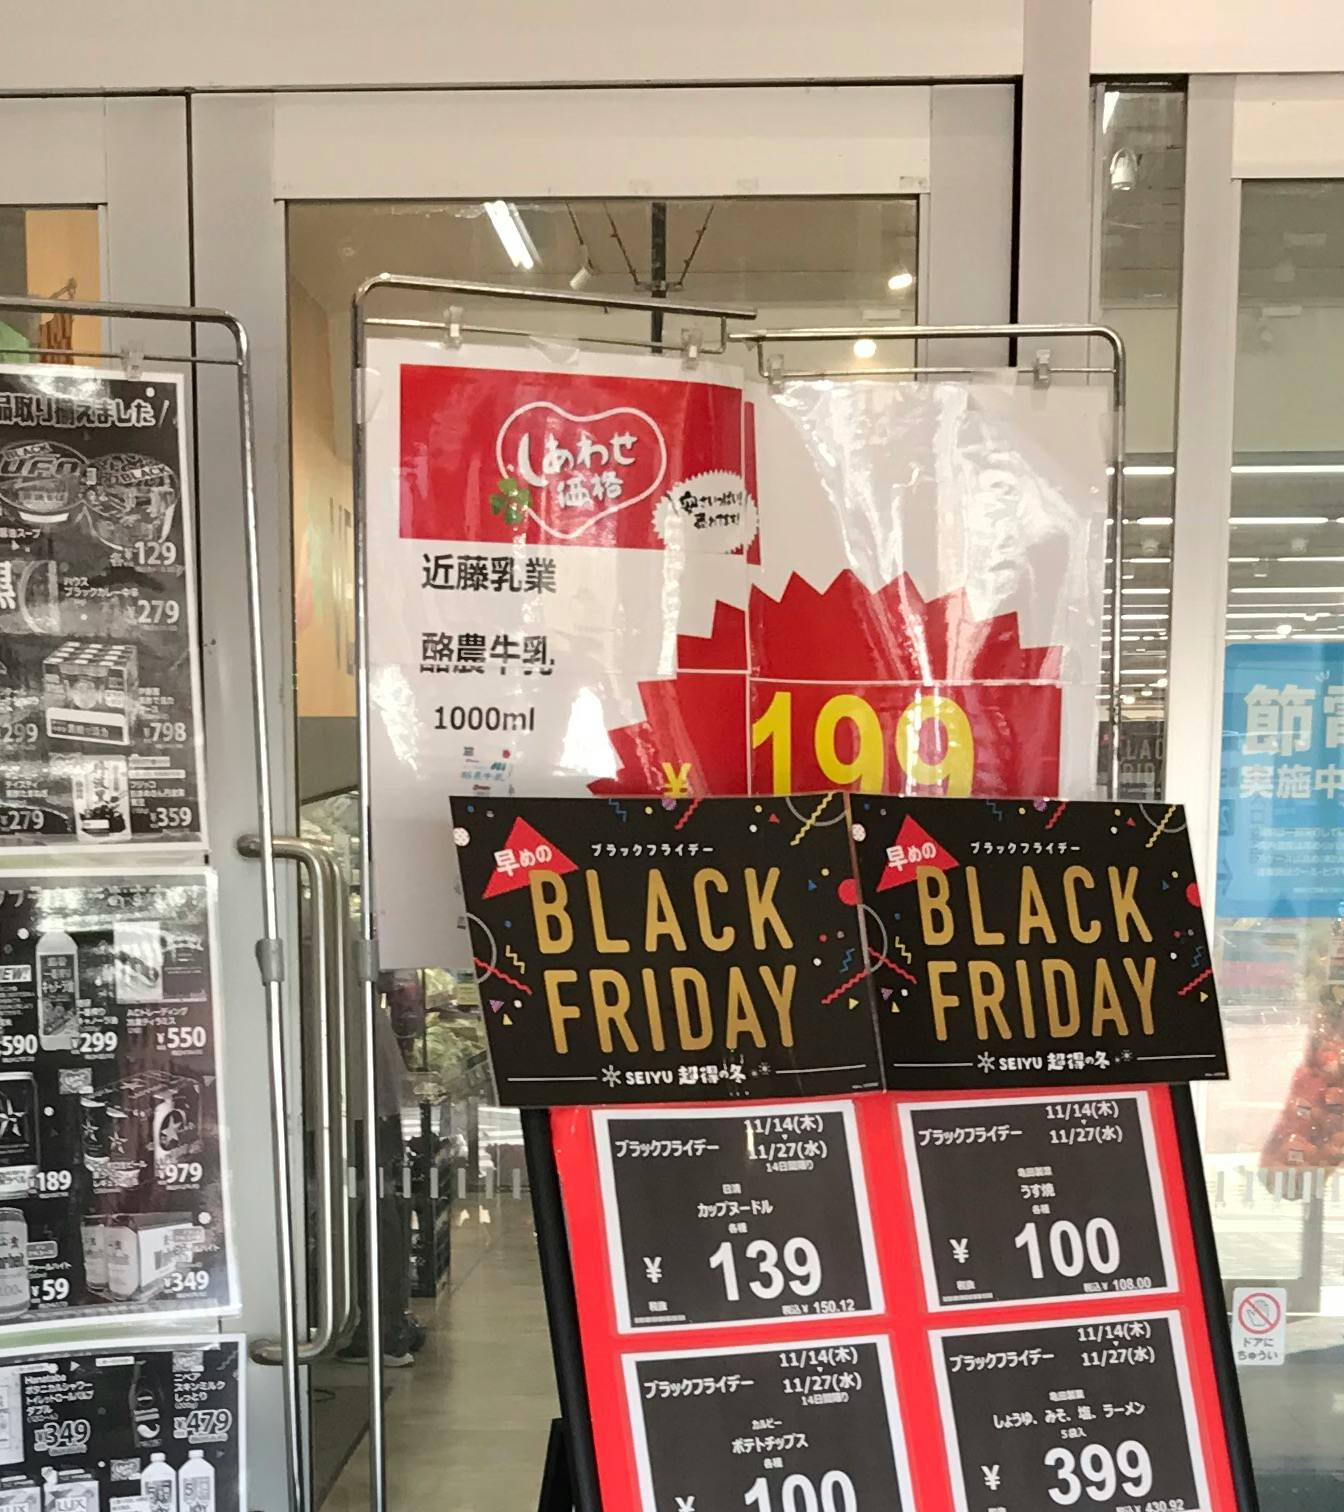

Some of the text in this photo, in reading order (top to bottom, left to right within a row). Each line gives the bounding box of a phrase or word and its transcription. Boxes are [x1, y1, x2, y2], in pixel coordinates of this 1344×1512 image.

[517, 431, 638, 488] しあわせ
[420, 553, 558, 595] 近藤乳業
[420, 630, 555, 676] 酪農牛乳
[431, 705, 537, 735] 1000ml
[751, 690, 976, 797] 199
[591, 840, 715, 859] ブラックフライデー
[886, 838, 938, 872] 早めの
[969, 840, 1082, 856] ブラックフライデー
[494, 842, 553, 877] 早めの
[529, 866, 795, 955] BLACK
[915, 864, 1154, 947] BLACK
[543, 962, 800, 1056] FRIDAY
[928, 956, 1159, 1042] FRIDAY
[999, 1056, 1044, 1073] SEIYU
[625, 1069, 675, 1087] SEIYU
[1045, 1101, 1120, 1120] 11/14(木)
[743, 1114, 824, 1136] 11/14(木)
[918, 1125, 1023, 1147] ブラックフライデー
[1049, 1125, 1123, 1145] 11/27(水)
[614, 1138, 720, 1158] ブラックフライデー
[748, 1140, 828, 1162] 11/27(水)
[1020, 1183, 1056, 1199] うす焼
[697, 1200, 774, 1218] カップヌードル
[1014, 1216, 1120, 1279] 100
[709, 1237, 822, 1302] 139
[1077, 1321, 1152, 1343] 11/14(木)
[779, 1347, 859, 1369] 11/14(木)
[949, 1349, 1055, 1374] ブラックフライデー
[1081, 1345, 1156, 1367] 11/27(水)
[643, 1376, 755, 1398] ブラックフライデー
[782, 1372, 862, 1394] 11/27(水)
[731, 1433, 809, 1454] ポテトチップス
[1045, 1440, 1153, 1506] 399
[58, 1497, 87, 1512] LUX
